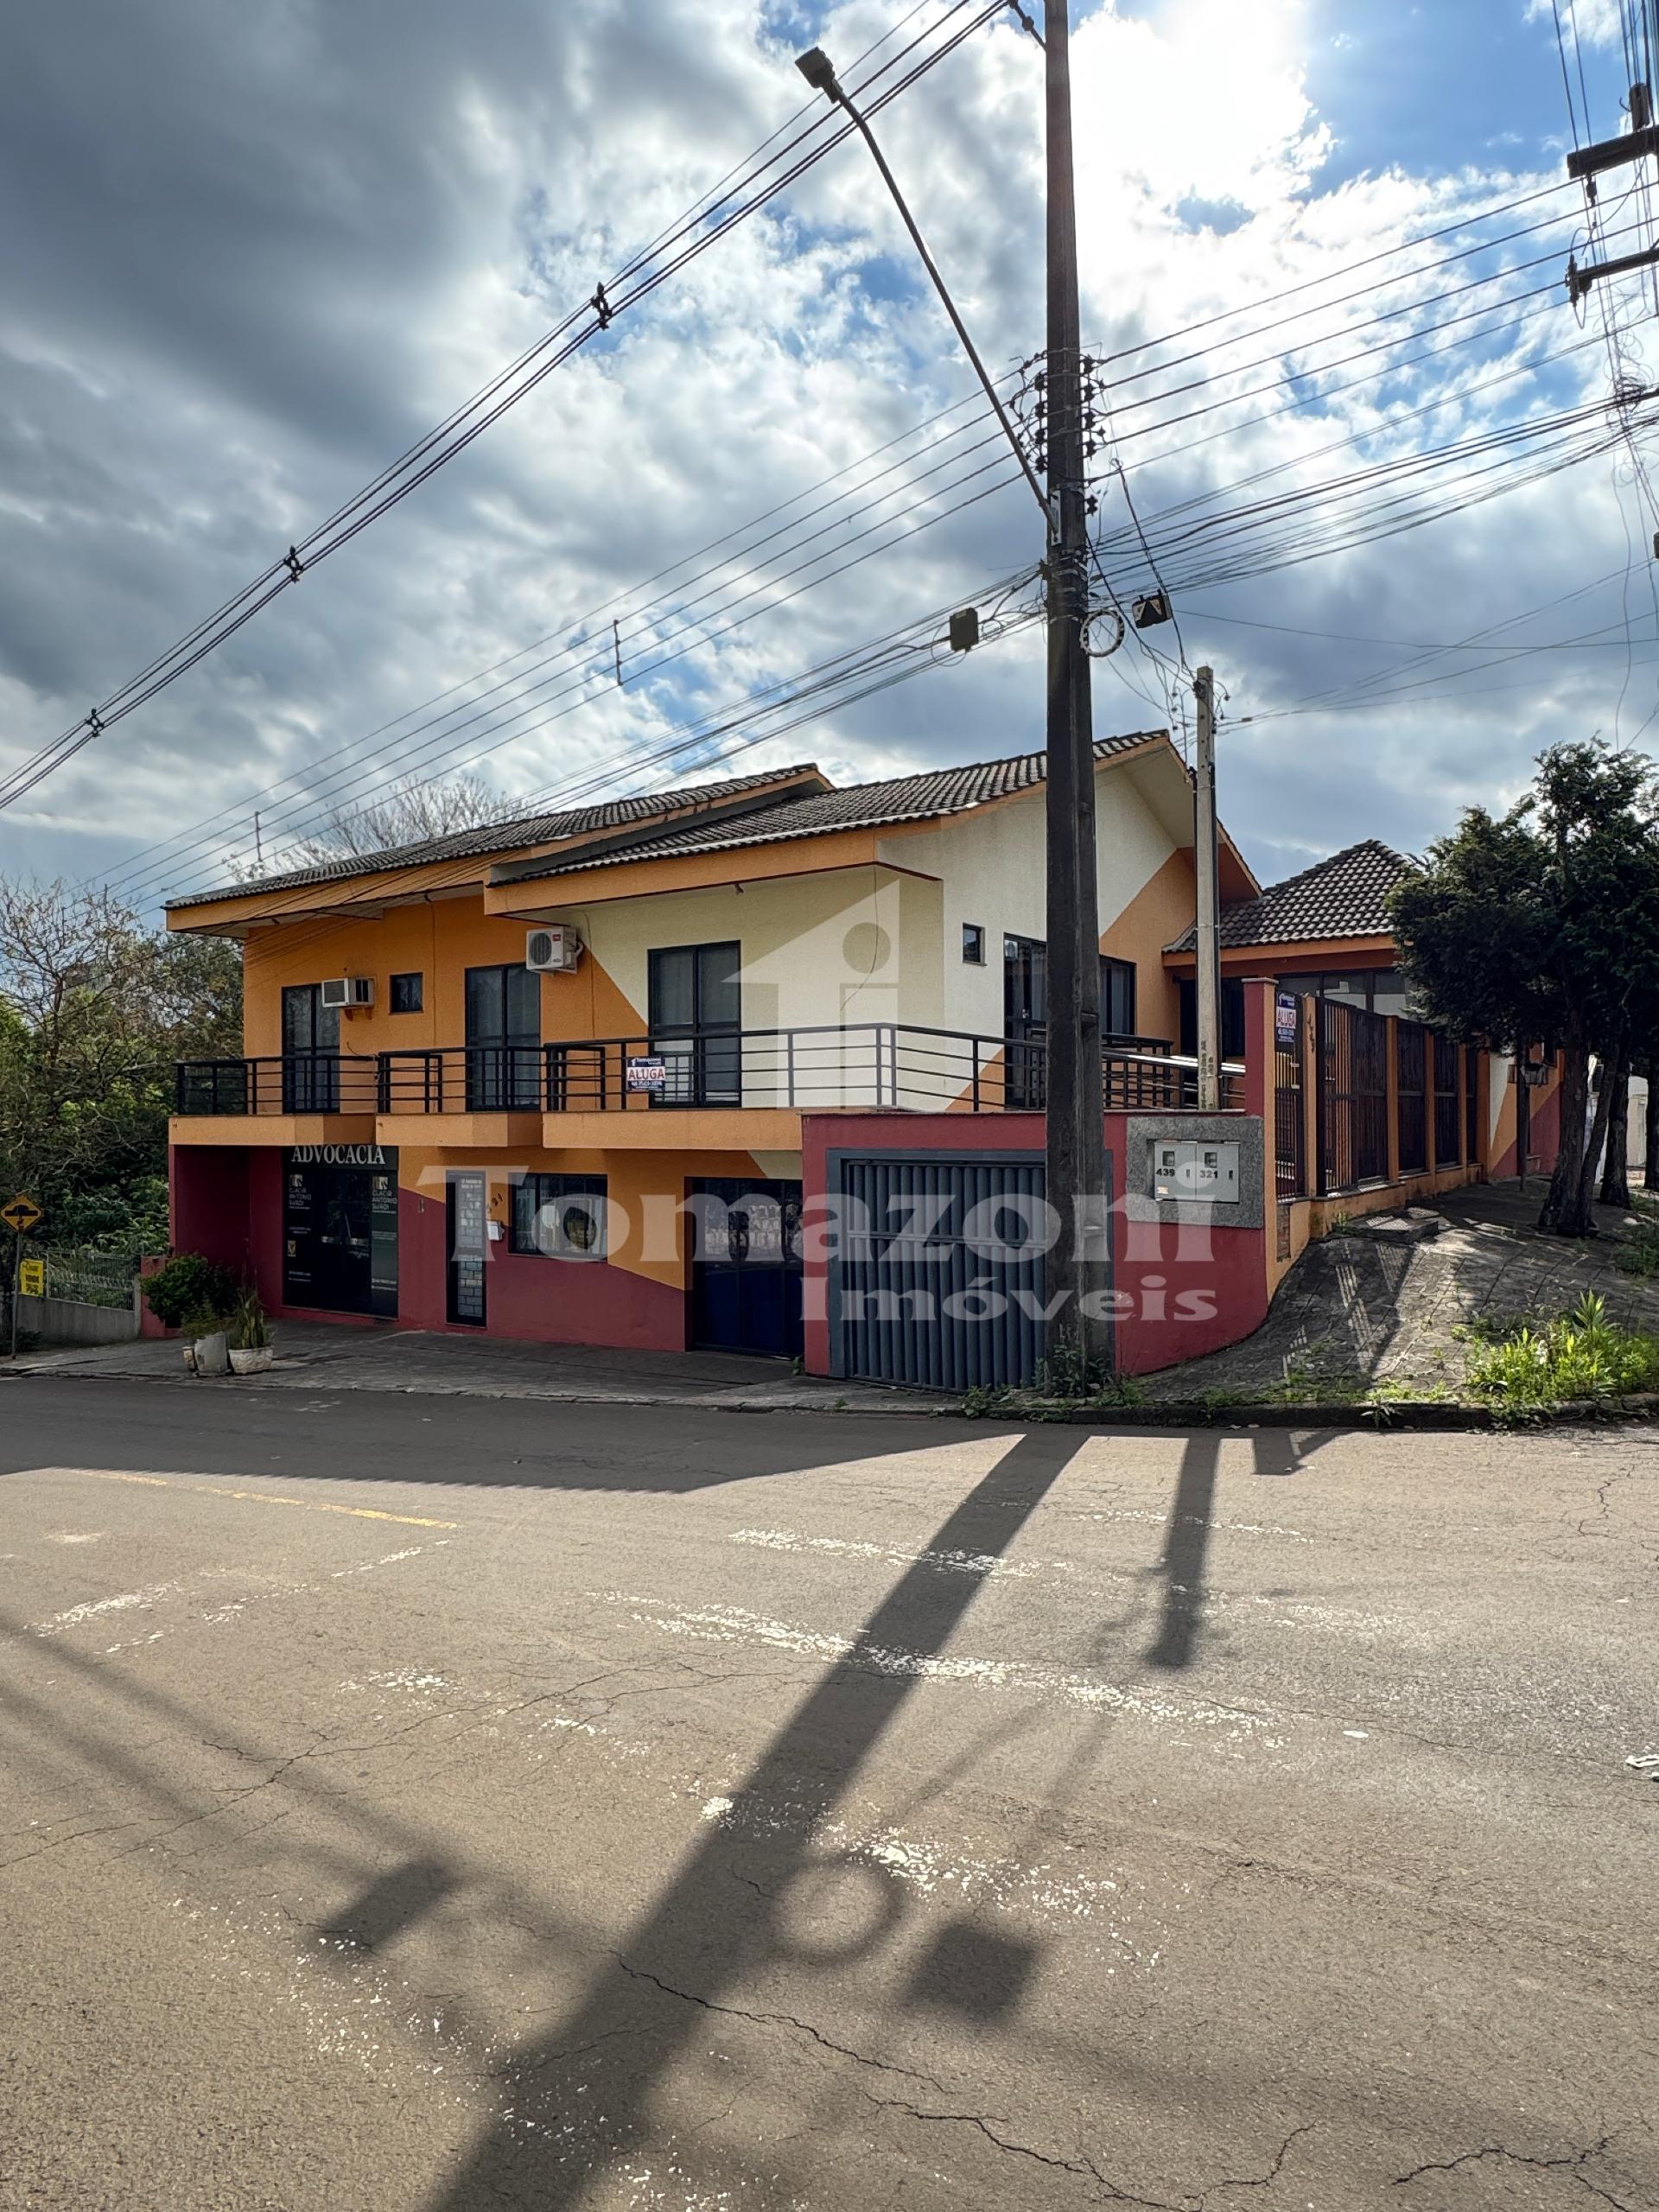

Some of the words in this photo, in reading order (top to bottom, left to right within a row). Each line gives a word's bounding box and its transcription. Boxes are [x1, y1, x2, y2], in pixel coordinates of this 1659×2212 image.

[629, 1068, 664, 1080] ALUGA
[290, 1144, 386, 1165] ADVOCACIA
[1155, 1168, 1175, 1177] 439
[1199, 1169, 1218, 1179] 321
